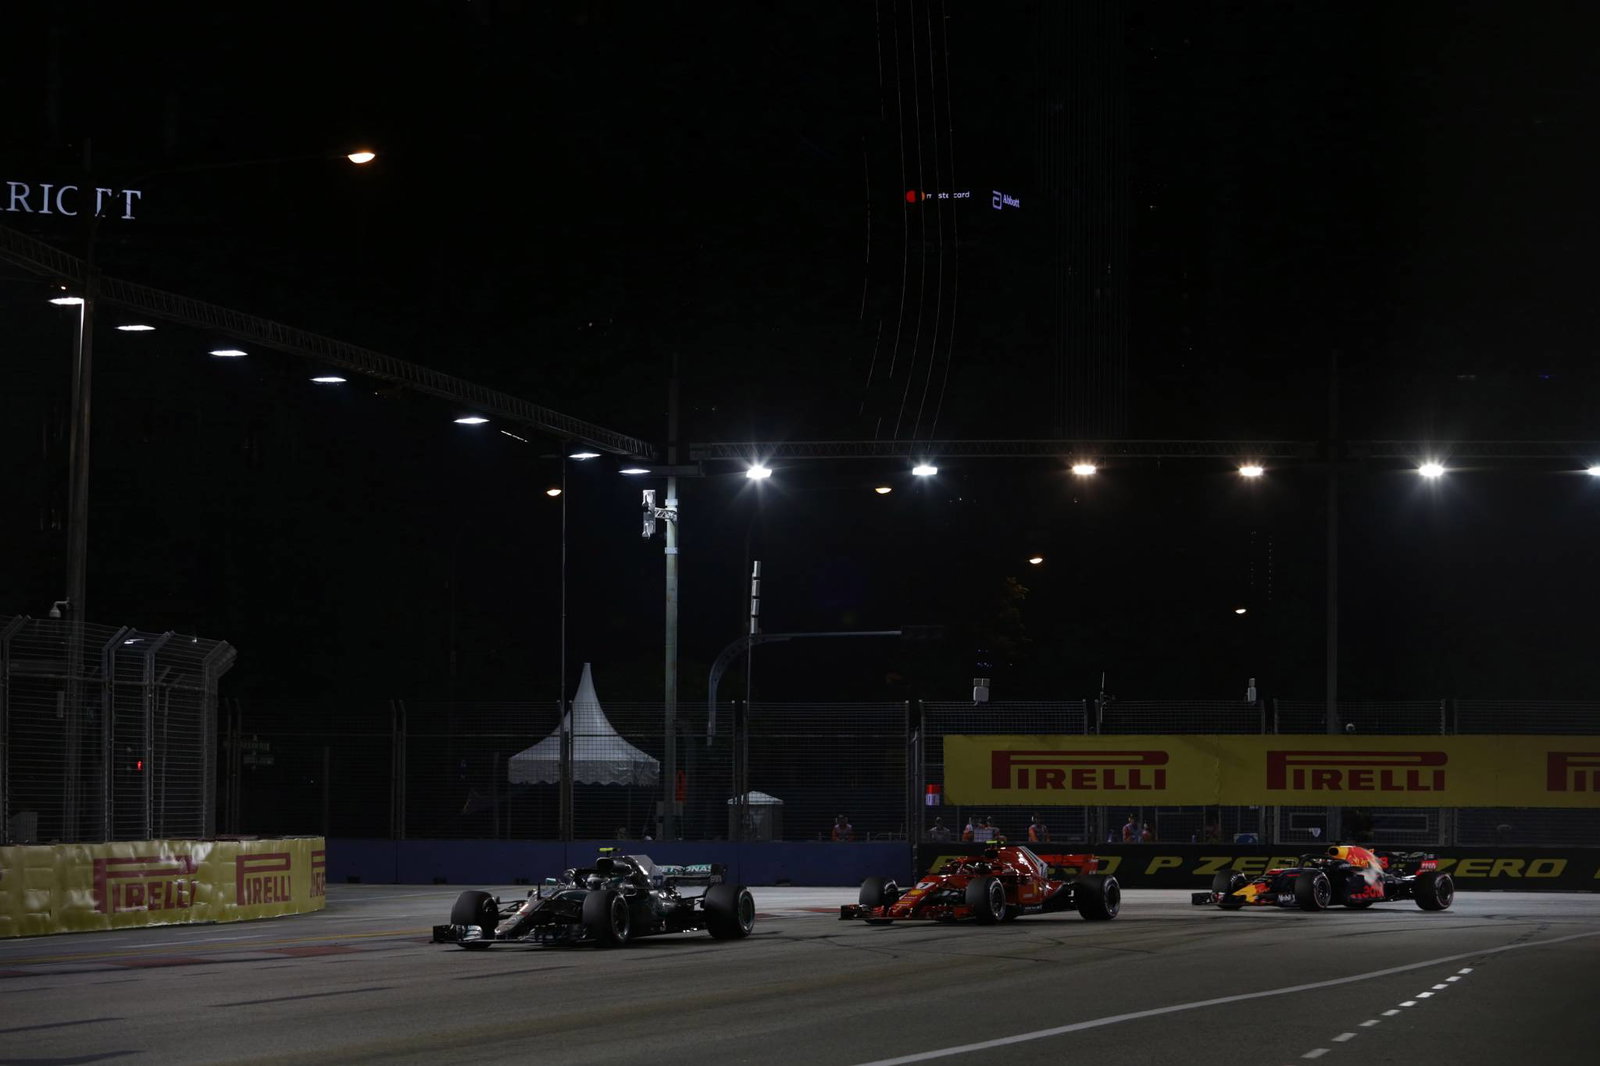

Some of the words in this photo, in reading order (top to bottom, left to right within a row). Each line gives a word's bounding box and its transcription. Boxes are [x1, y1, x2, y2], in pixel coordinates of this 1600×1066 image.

[991, 750, 1168, 790] PIRELLI
[1266, 750, 1448, 791] PIRELLI
[93, 855, 199, 914] PIRELLI
[235, 852, 292, 906] PIRELLI
[1144, 856, 1184, 875] P
